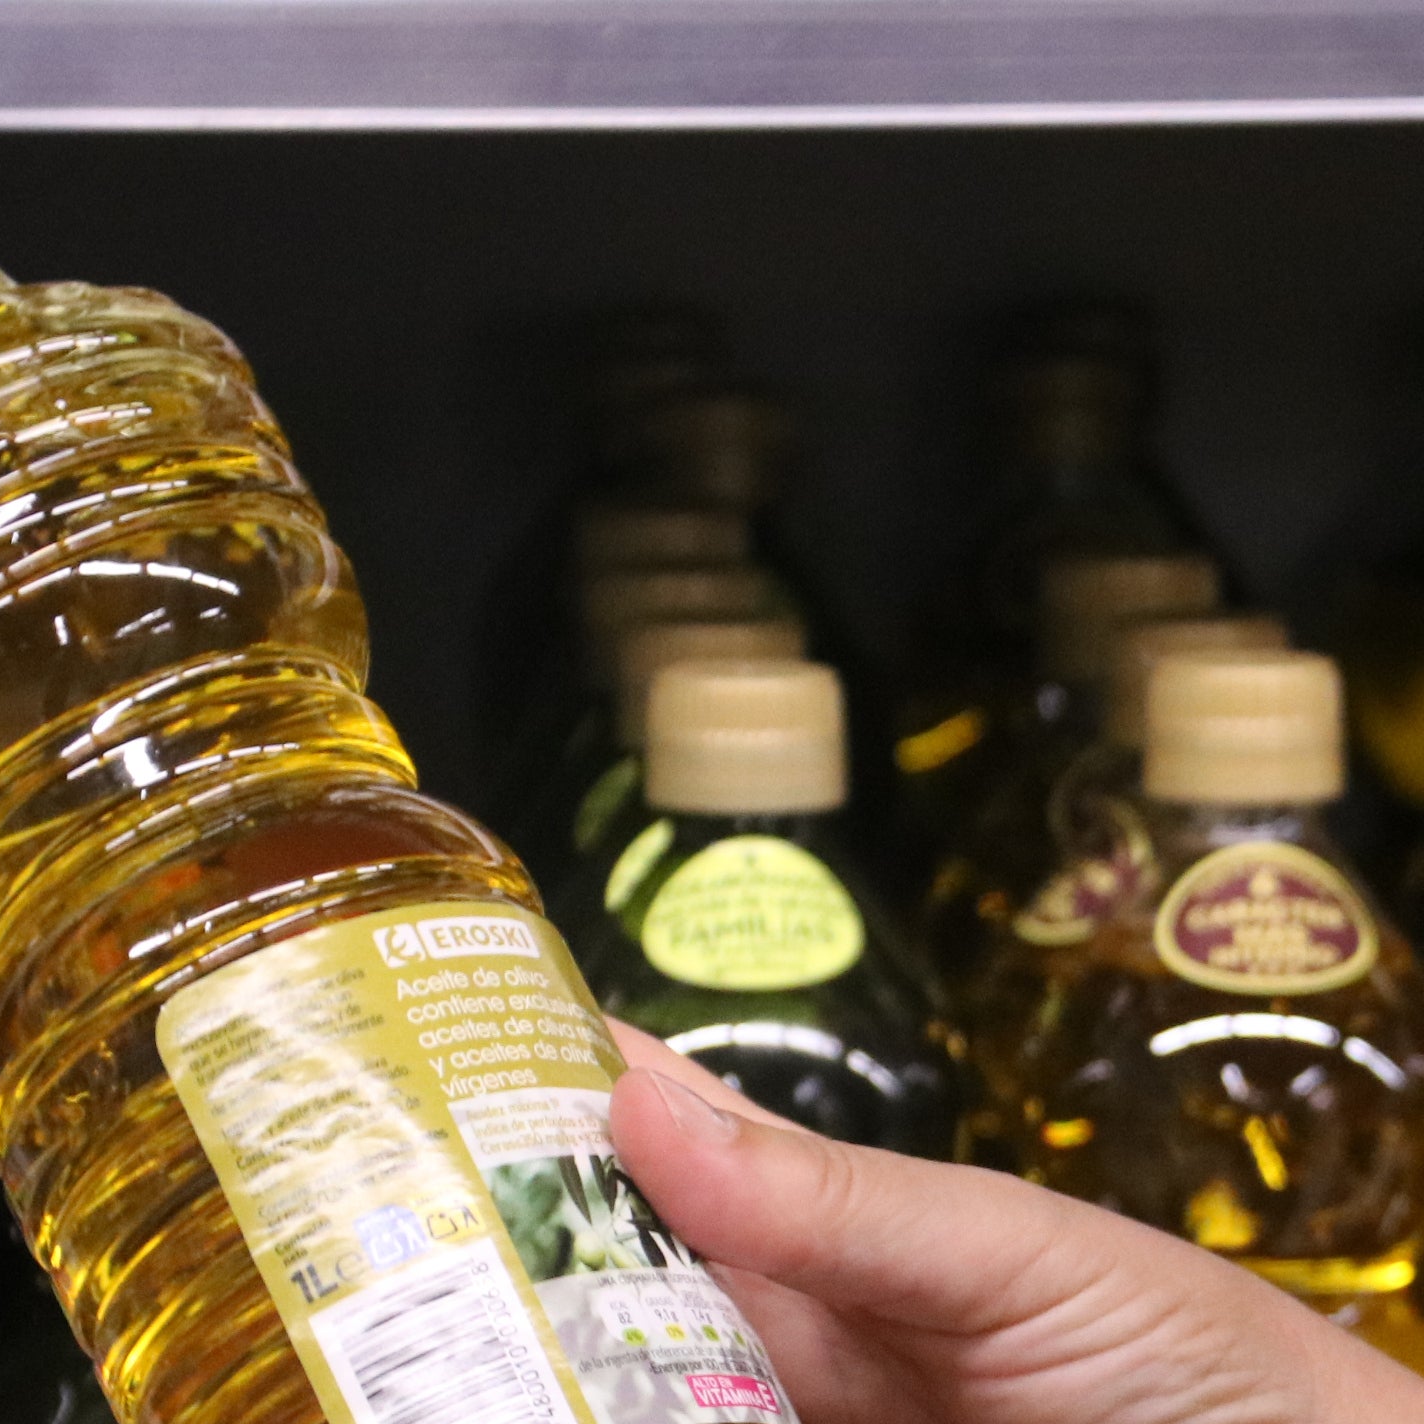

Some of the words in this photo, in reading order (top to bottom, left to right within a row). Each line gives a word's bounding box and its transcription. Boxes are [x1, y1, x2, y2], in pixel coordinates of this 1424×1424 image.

[429, 924, 531, 950] EROSKI
[396, 968, 469, 1002] Aceite
[473, 966, 501, 989] de
[406, 993, 506, 1025] contiene
[418, 1019, 501, 1049] aceites
[504, 1015, 534, 1036] de
[537, 1016, 576, 1039] oliva
[428, 1056, 445, 1079] y
[450, 1042, 532, 1069] aceites
[534, 1039, 558, 1060] de
[560, 1043, 600, 1066] oliva
[440, 1066, 538, 1099] vírgenes
[290, 1262, 339, 1303] 1L
[691, 1376, 717, 1389] ALTO
[719, 1377, 733, 1389] EN
[696, 1386, 762, 1407] VITAMINA
[756, 1382, 776, 1410] E
